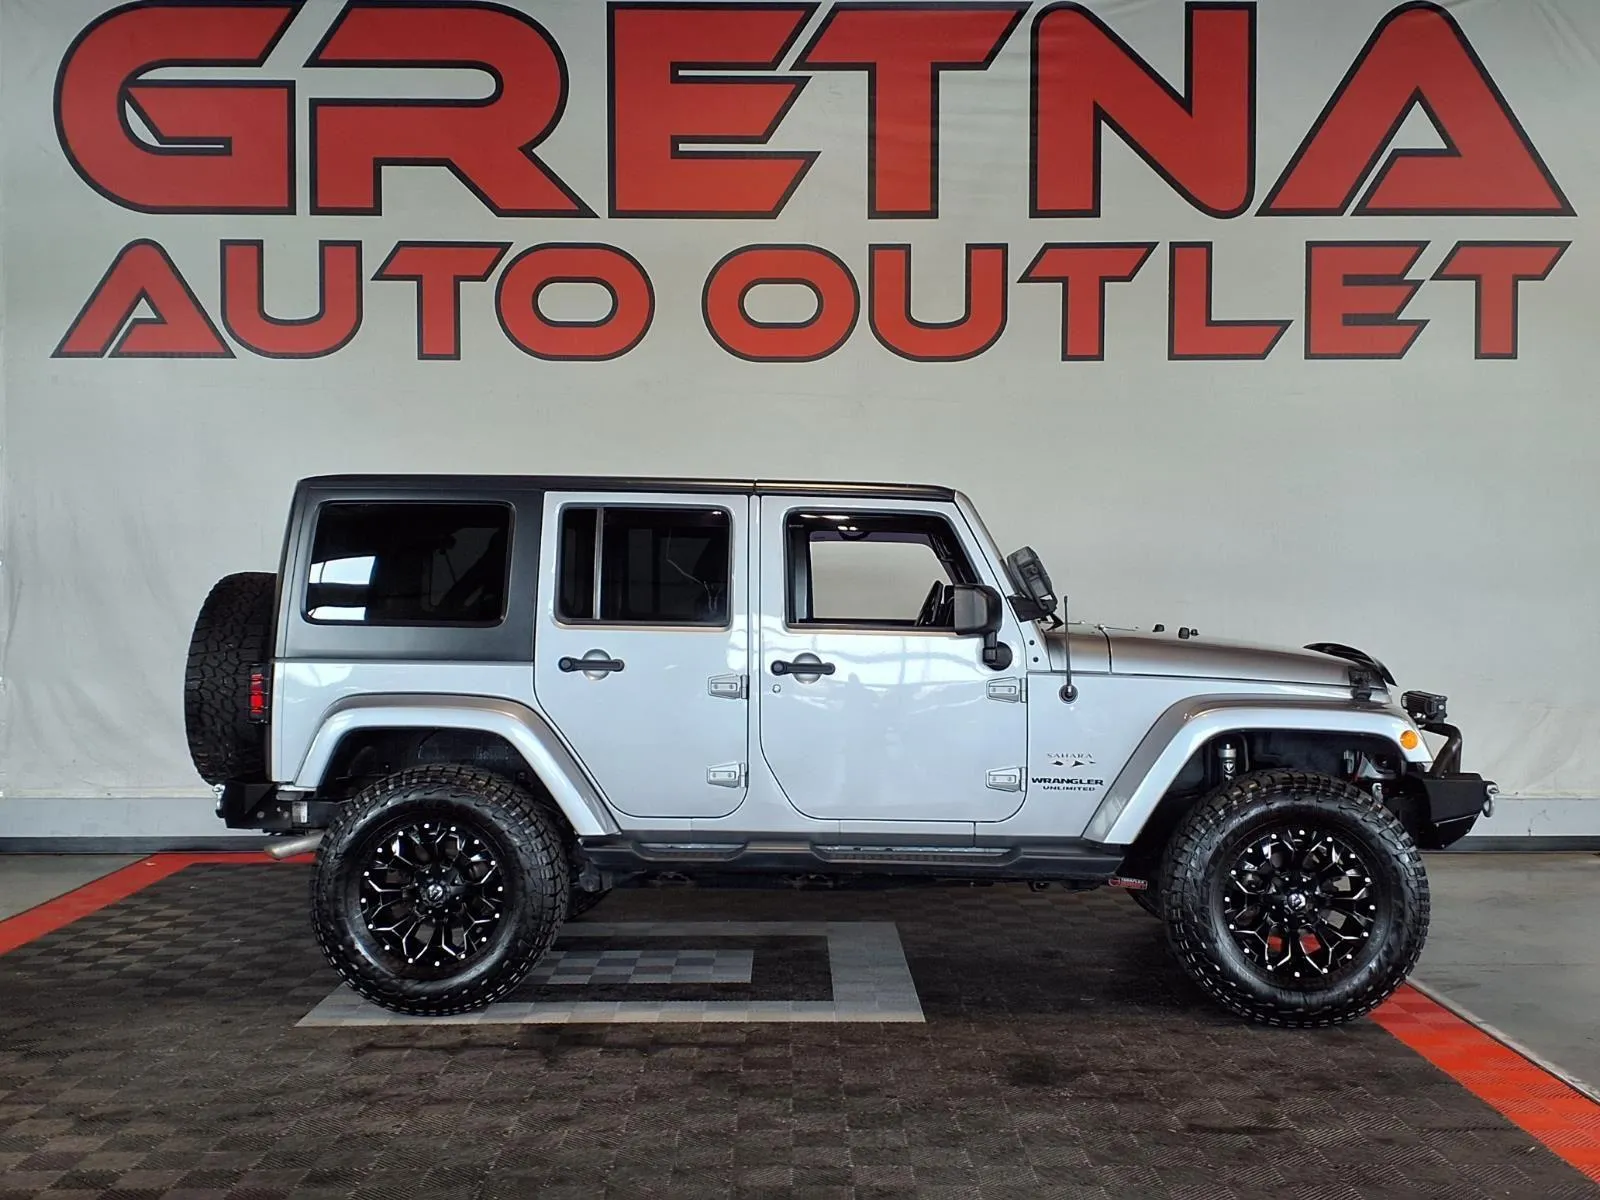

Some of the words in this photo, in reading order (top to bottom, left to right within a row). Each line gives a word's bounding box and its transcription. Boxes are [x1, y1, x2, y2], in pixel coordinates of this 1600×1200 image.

[53, 0, 1577, 219] GRETNA
[51, 238, 655, 361] AUTO
[702, 240, 1573, 362] OUTLET
[1031, 776, 1104, 786] WRANGLER
